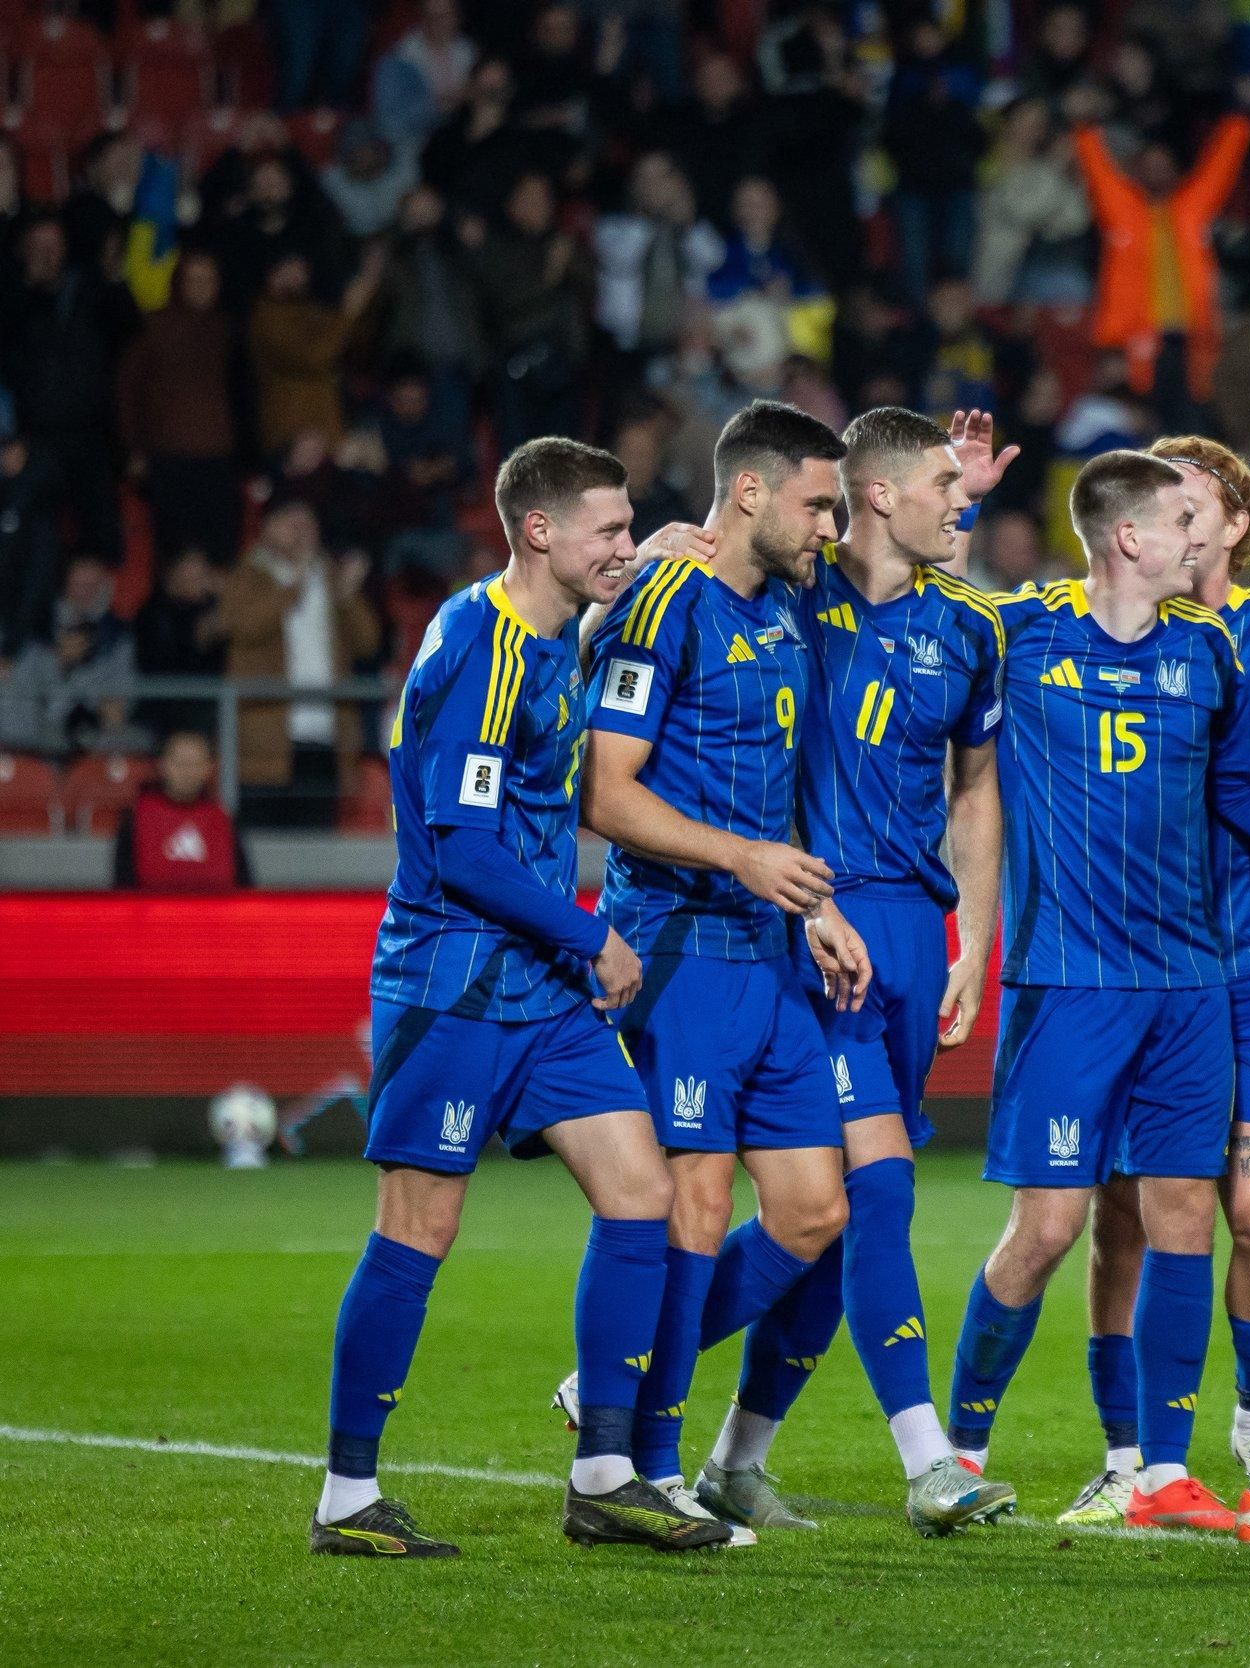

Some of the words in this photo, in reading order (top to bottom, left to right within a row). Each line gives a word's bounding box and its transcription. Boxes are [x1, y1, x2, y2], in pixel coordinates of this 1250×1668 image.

[776, 686, 795, 750] 9
[856, 681, 895, 747] 11
[1099, 711, 1147, 774] 15
[438, 1143, 467, 1154] UKRAINE
[673, 1120, 703, 1130] UKRAINE
